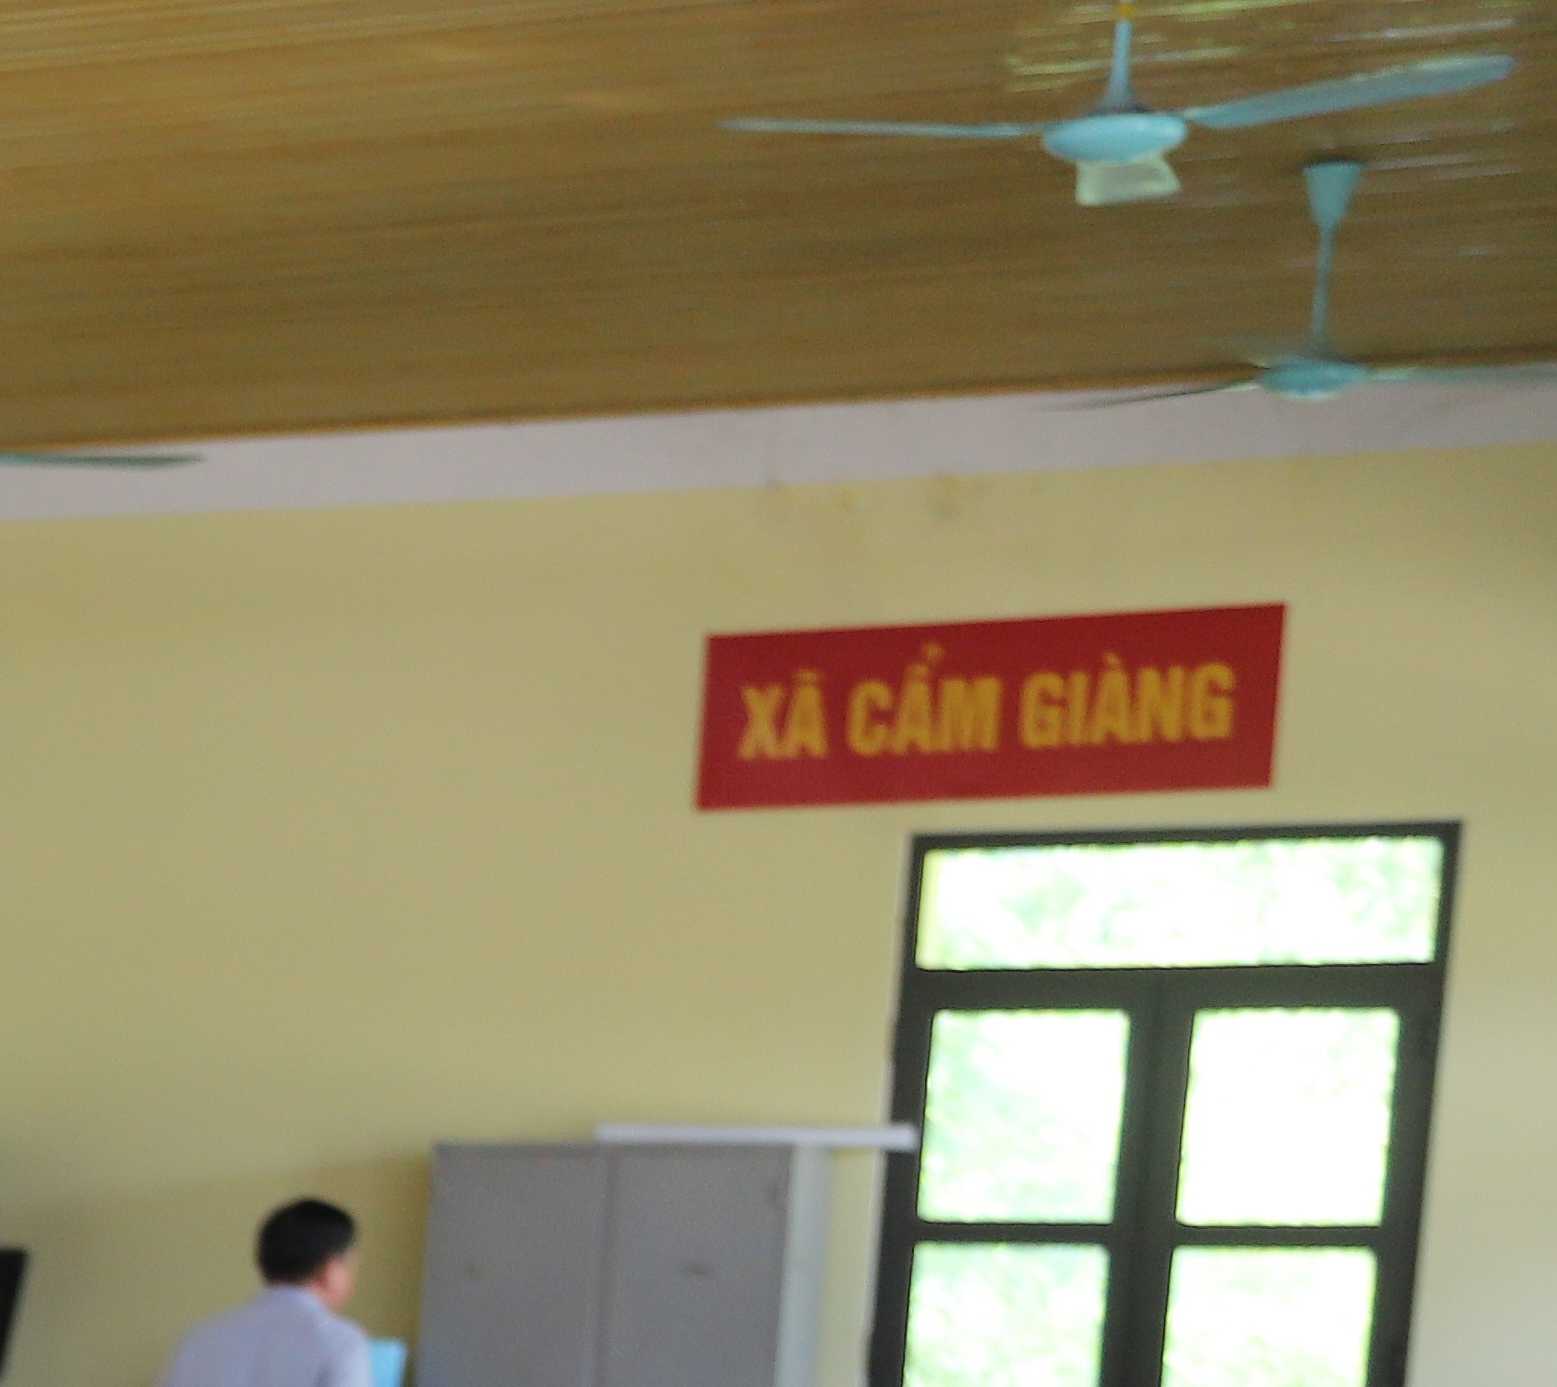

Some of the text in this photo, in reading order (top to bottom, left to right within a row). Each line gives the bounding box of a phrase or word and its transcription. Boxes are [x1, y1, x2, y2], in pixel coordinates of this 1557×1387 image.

[738, 642, 1237, 761] XÃ CẨM GIÀNG
